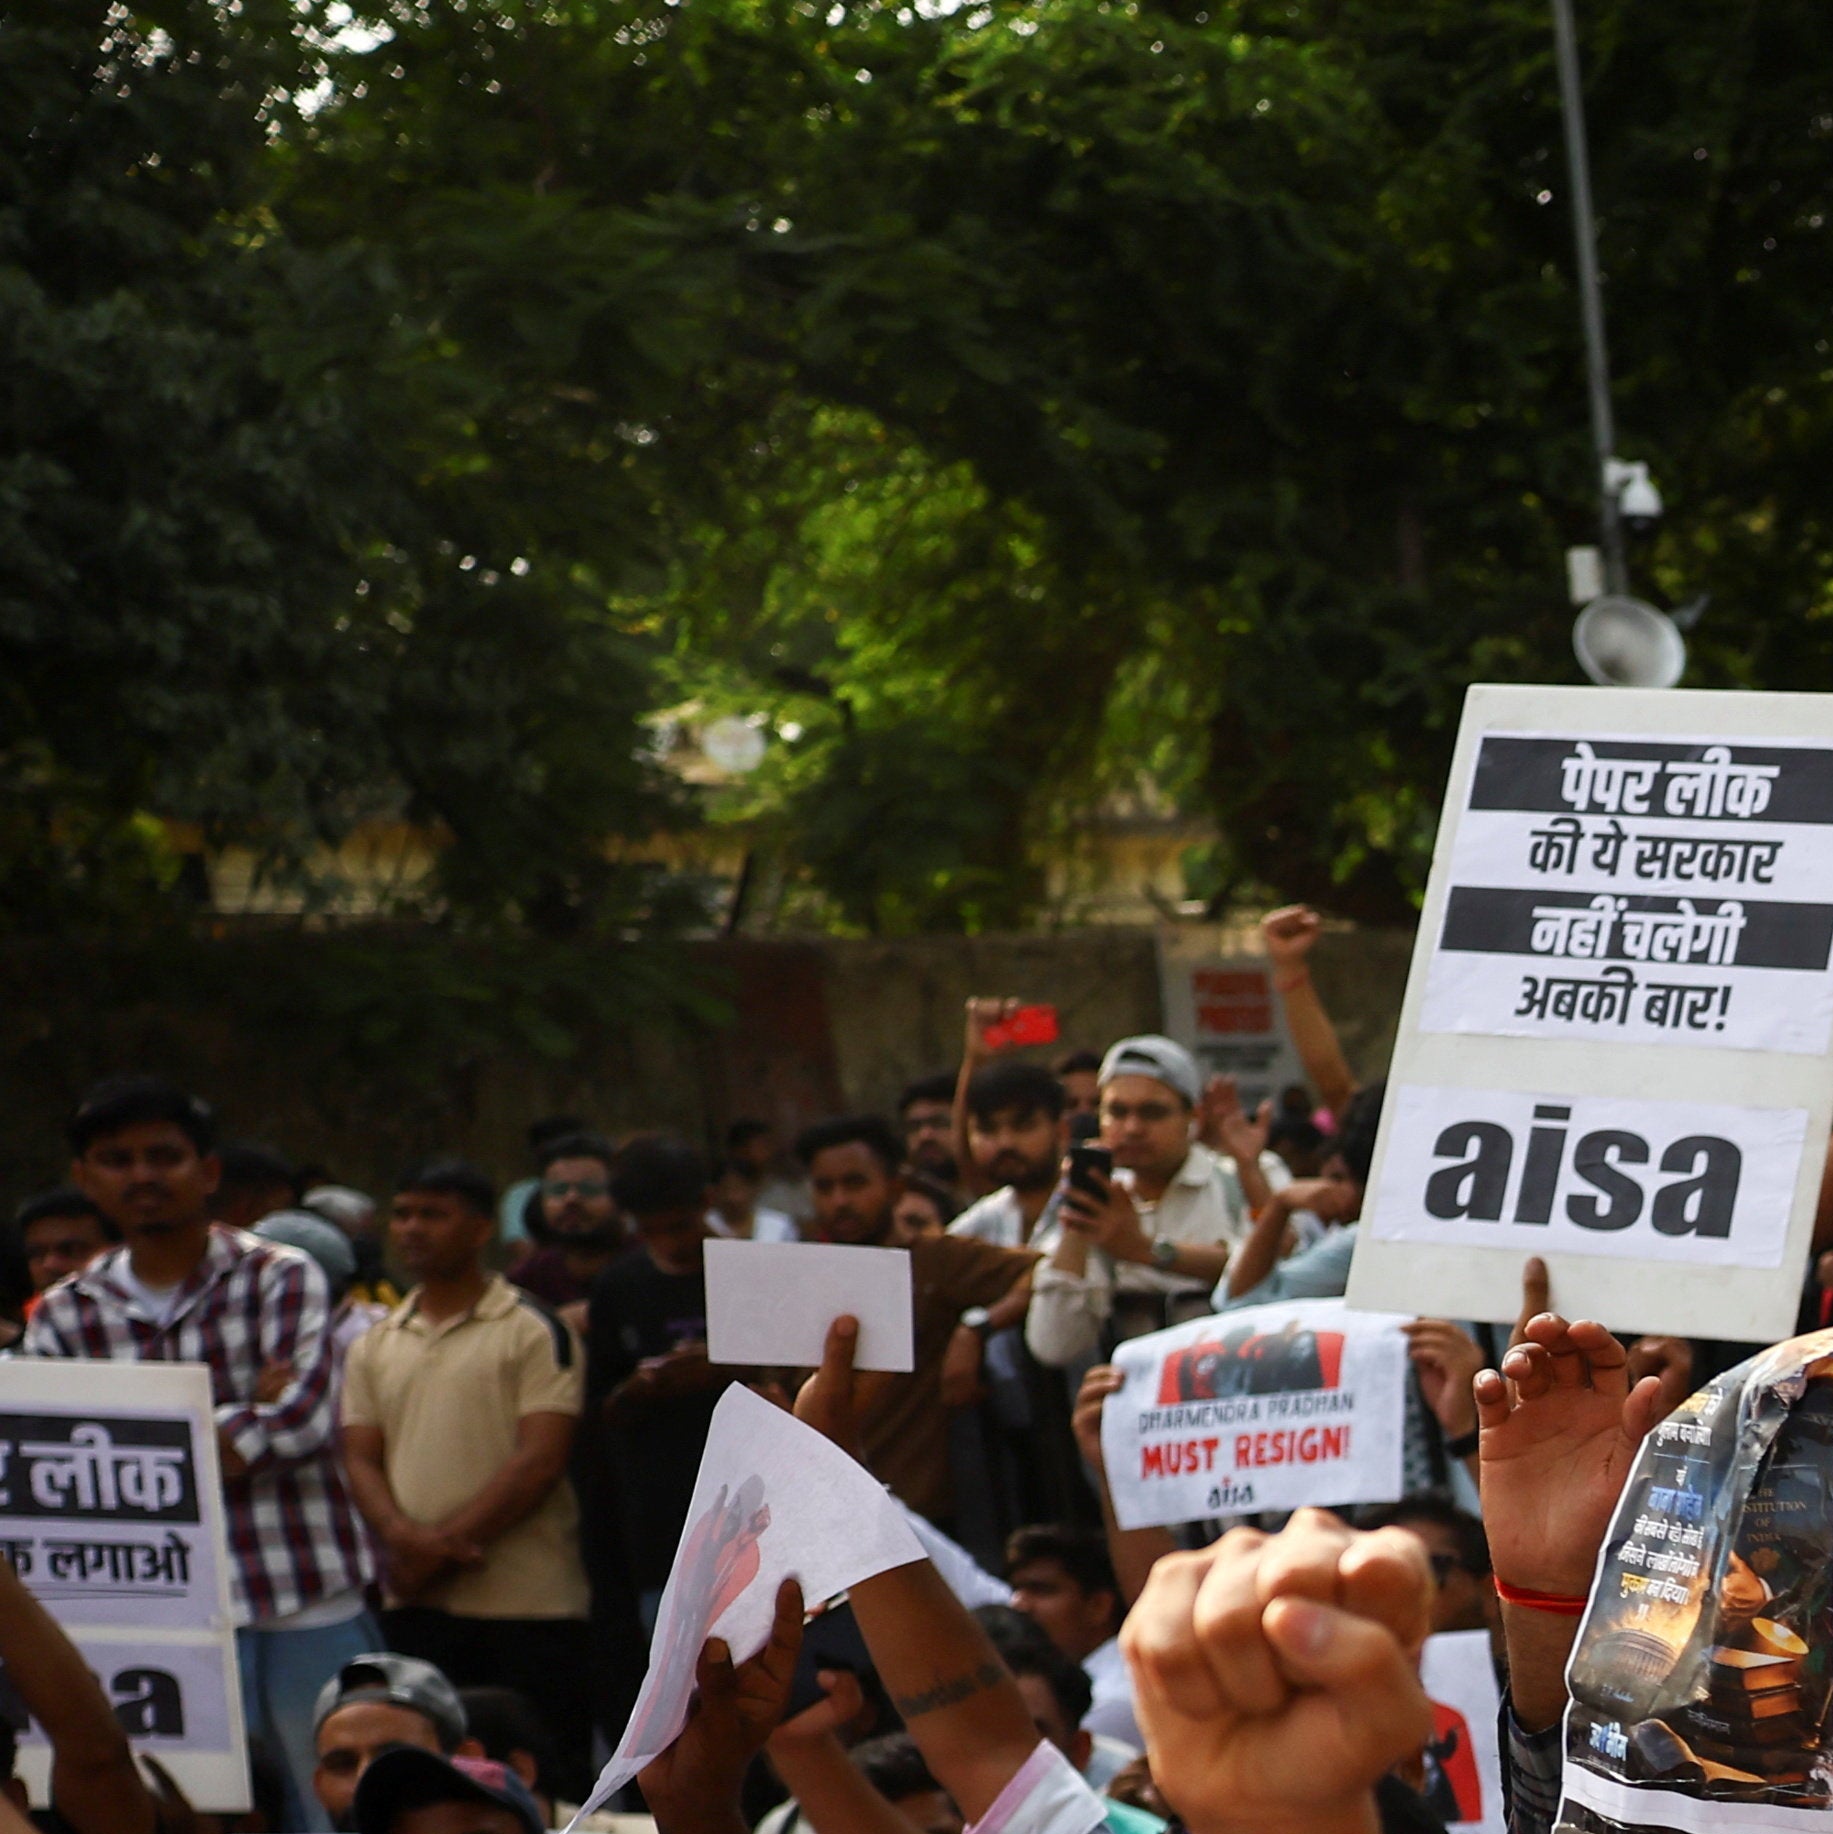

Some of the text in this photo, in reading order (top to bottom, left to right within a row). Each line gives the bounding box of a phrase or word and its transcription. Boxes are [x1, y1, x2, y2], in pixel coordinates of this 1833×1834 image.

[1562, 742, 1780, 817] पेपर लीक
[1529, 818, 1784, 882] की ये सरकार
[1530, 896, 1747, 964] नहीं चलेगी
[1514, 966, 1732, 1031] अबकी बार!
[1424, 1105, 1742, 1239] aisa
[1139, 1393, 1355, 1434] DHARMENDRA PRADHAN
[20, 1425, 185, 1512] लीक
[1141, 1425, 1351, 1480] MUST RESIGN!
[48, 1531, 190, 1589] लगाओ
